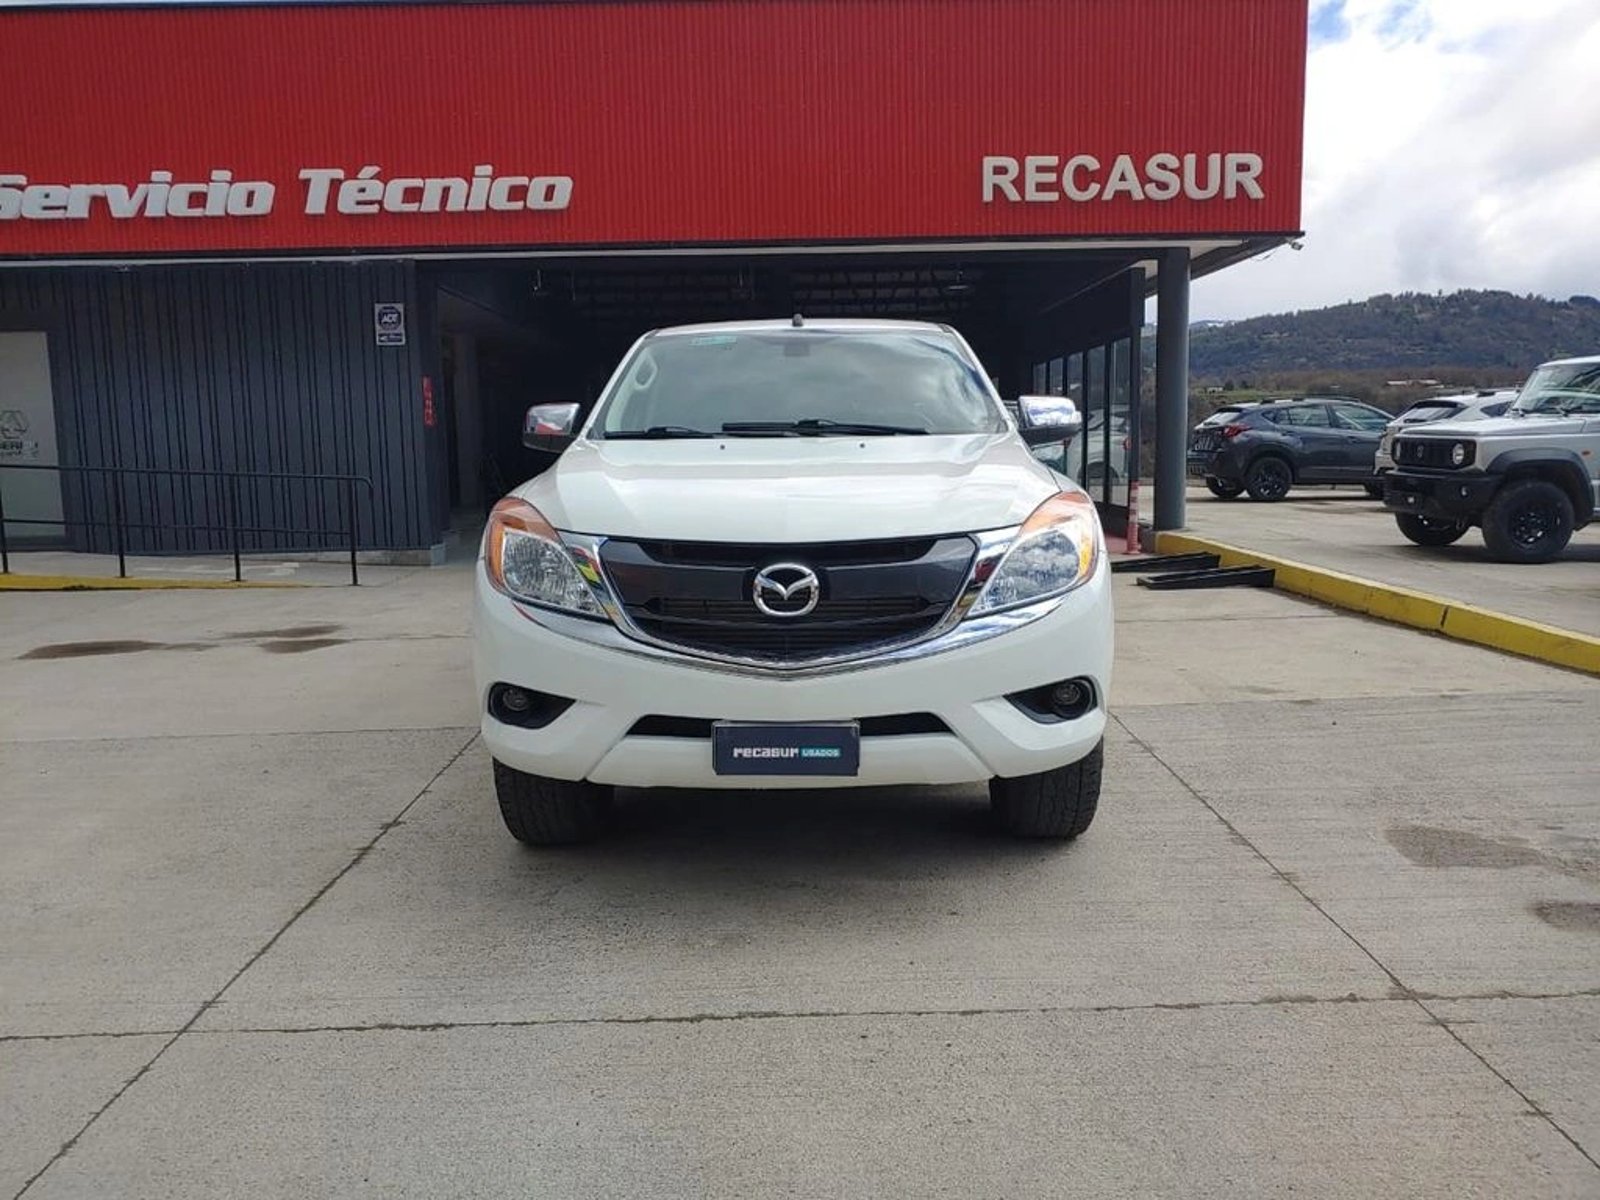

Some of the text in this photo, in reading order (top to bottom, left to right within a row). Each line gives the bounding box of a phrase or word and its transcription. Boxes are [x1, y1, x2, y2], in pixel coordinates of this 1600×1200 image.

[0, 164, 574, 220] Servicio Técnico
[981, 152, 1265, 203] RECASUR
[733, 747, 841, 758] recasur USADOS
